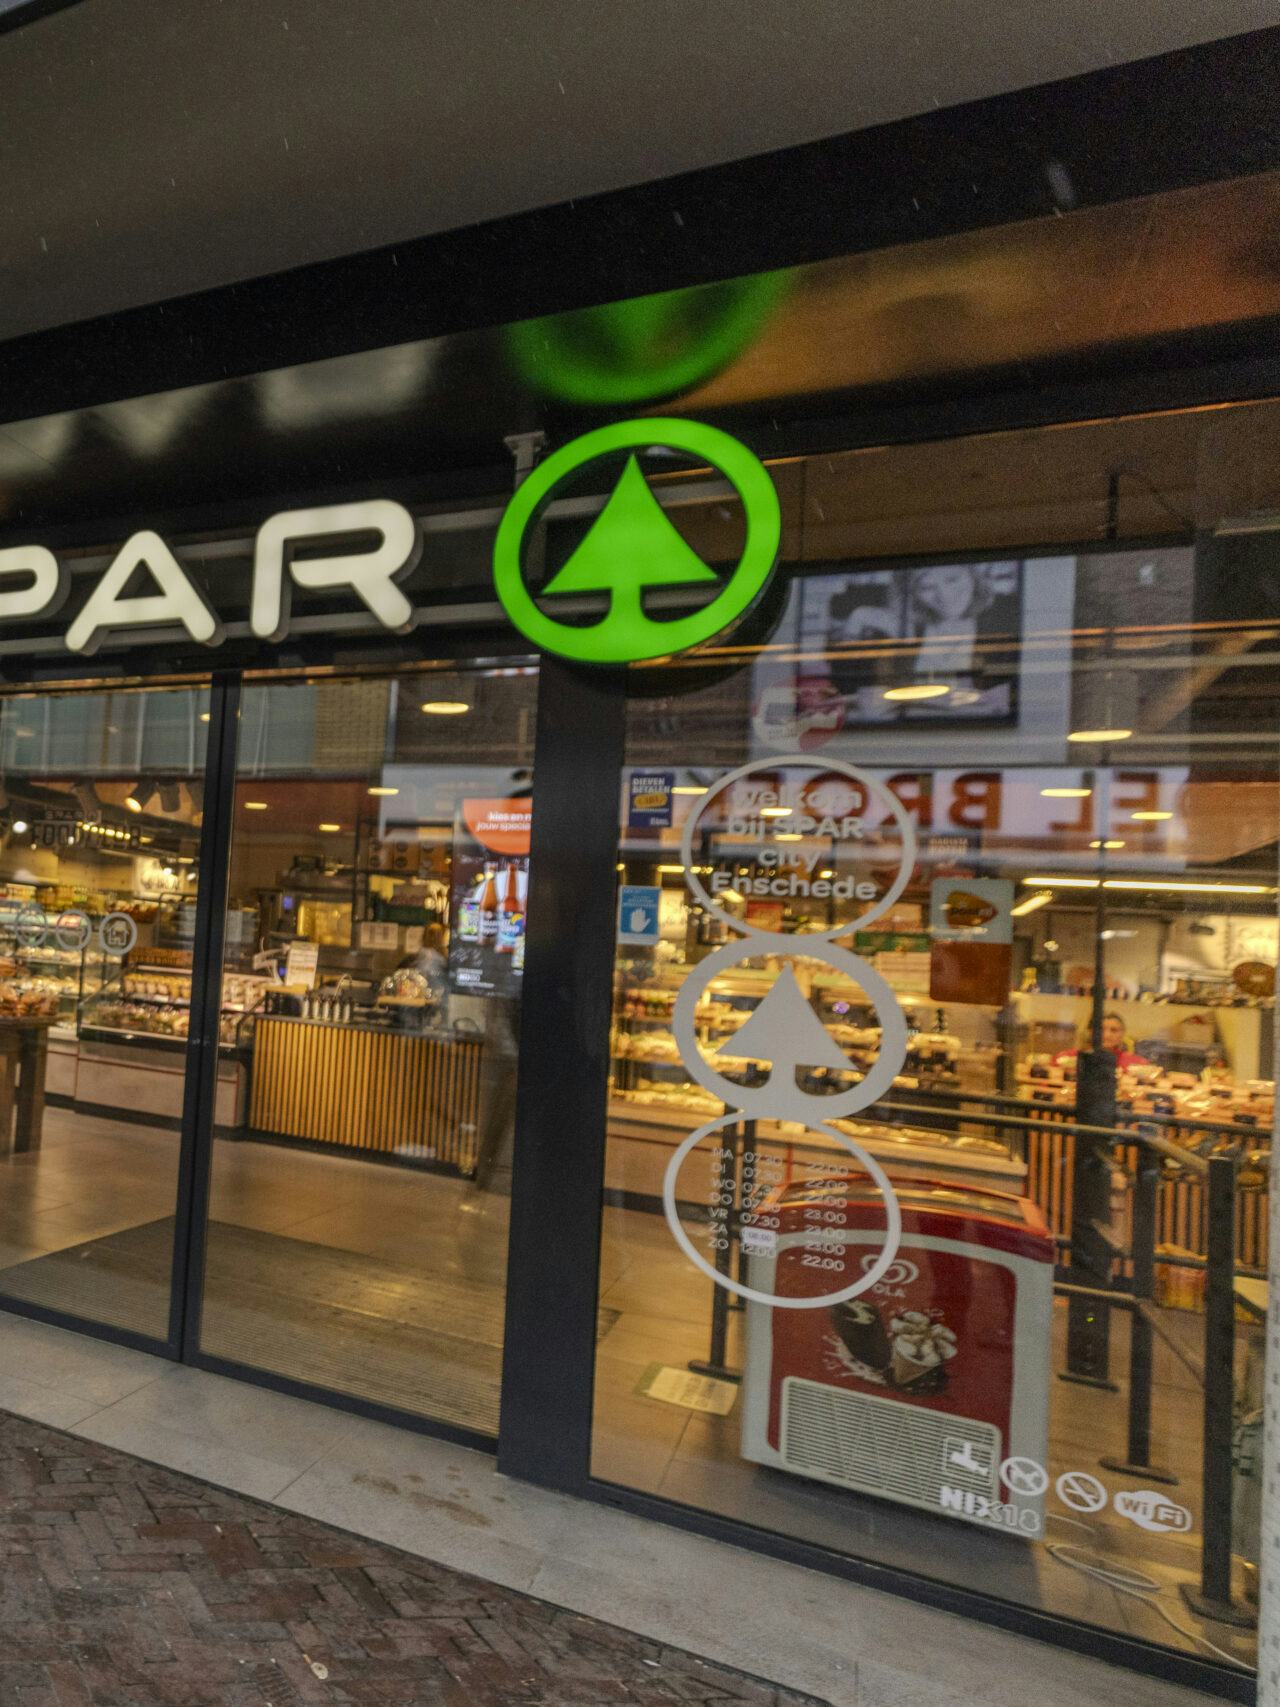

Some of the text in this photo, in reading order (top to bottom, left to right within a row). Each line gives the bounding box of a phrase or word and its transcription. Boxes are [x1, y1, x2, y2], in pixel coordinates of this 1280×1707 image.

[633, 777, 666, 785] DIEVEN
[733, 787, 863, 809] welkom
[726, 814, 865, 841] bij SPAR
[758, 849, 820, 873] city
[711, 871, 877, 900] Enschede
[712, 1179, 736, 1191] WO
[708, 1207, 728, 1219] VR
[740, 1212, 781, 1229] 07.30
[709, 1222, 728, 1235] ZA
[708, 1238, 729, 1250] ZO
[801, 1254, 846, 1271] 22.00
[873, 1283, 906, 1298] OLA
[940, 1486, 1041, 1533] NIX18
